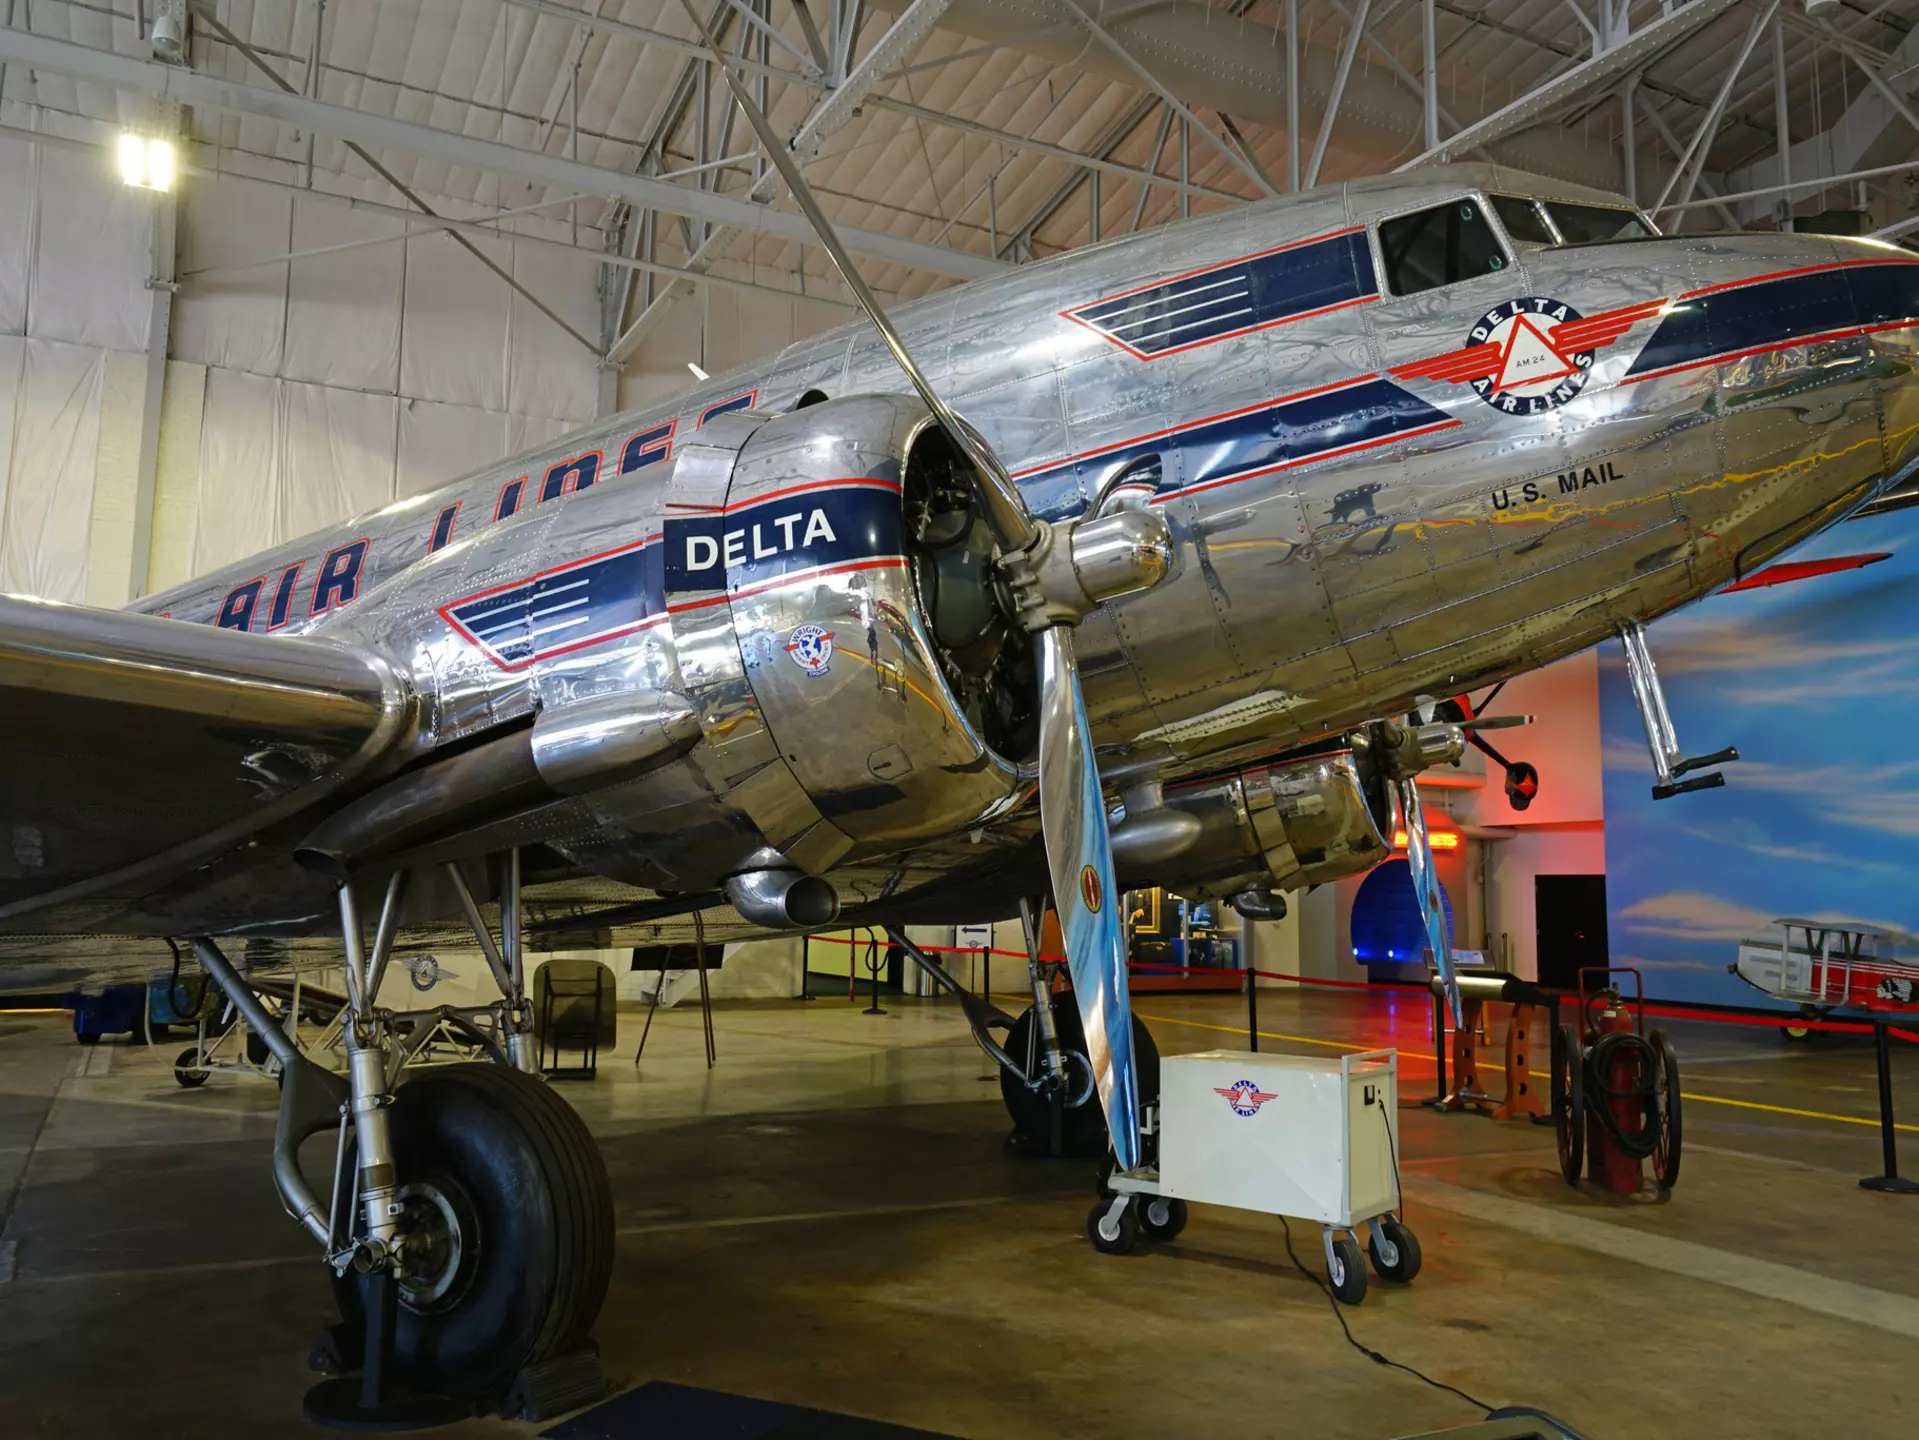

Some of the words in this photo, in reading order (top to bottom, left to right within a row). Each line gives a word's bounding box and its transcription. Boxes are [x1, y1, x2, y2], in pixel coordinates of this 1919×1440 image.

[1471, 298, 1565, 341] DELTA
[1516, 358, 1531, 368] AM
[1532, 355, 1546, 365] 24
[1473, 378, 1517, 413] AIR
[1529, 354, 1593, 413] LINES
[1558, 462, 1624, 494] MAIL
[215, 537, 371, 632] AIR
[428, 389, 758, 555] LINE
[686, 508, 836, 571] DELTA
[791, 626, 823, 643] WRIGHT
